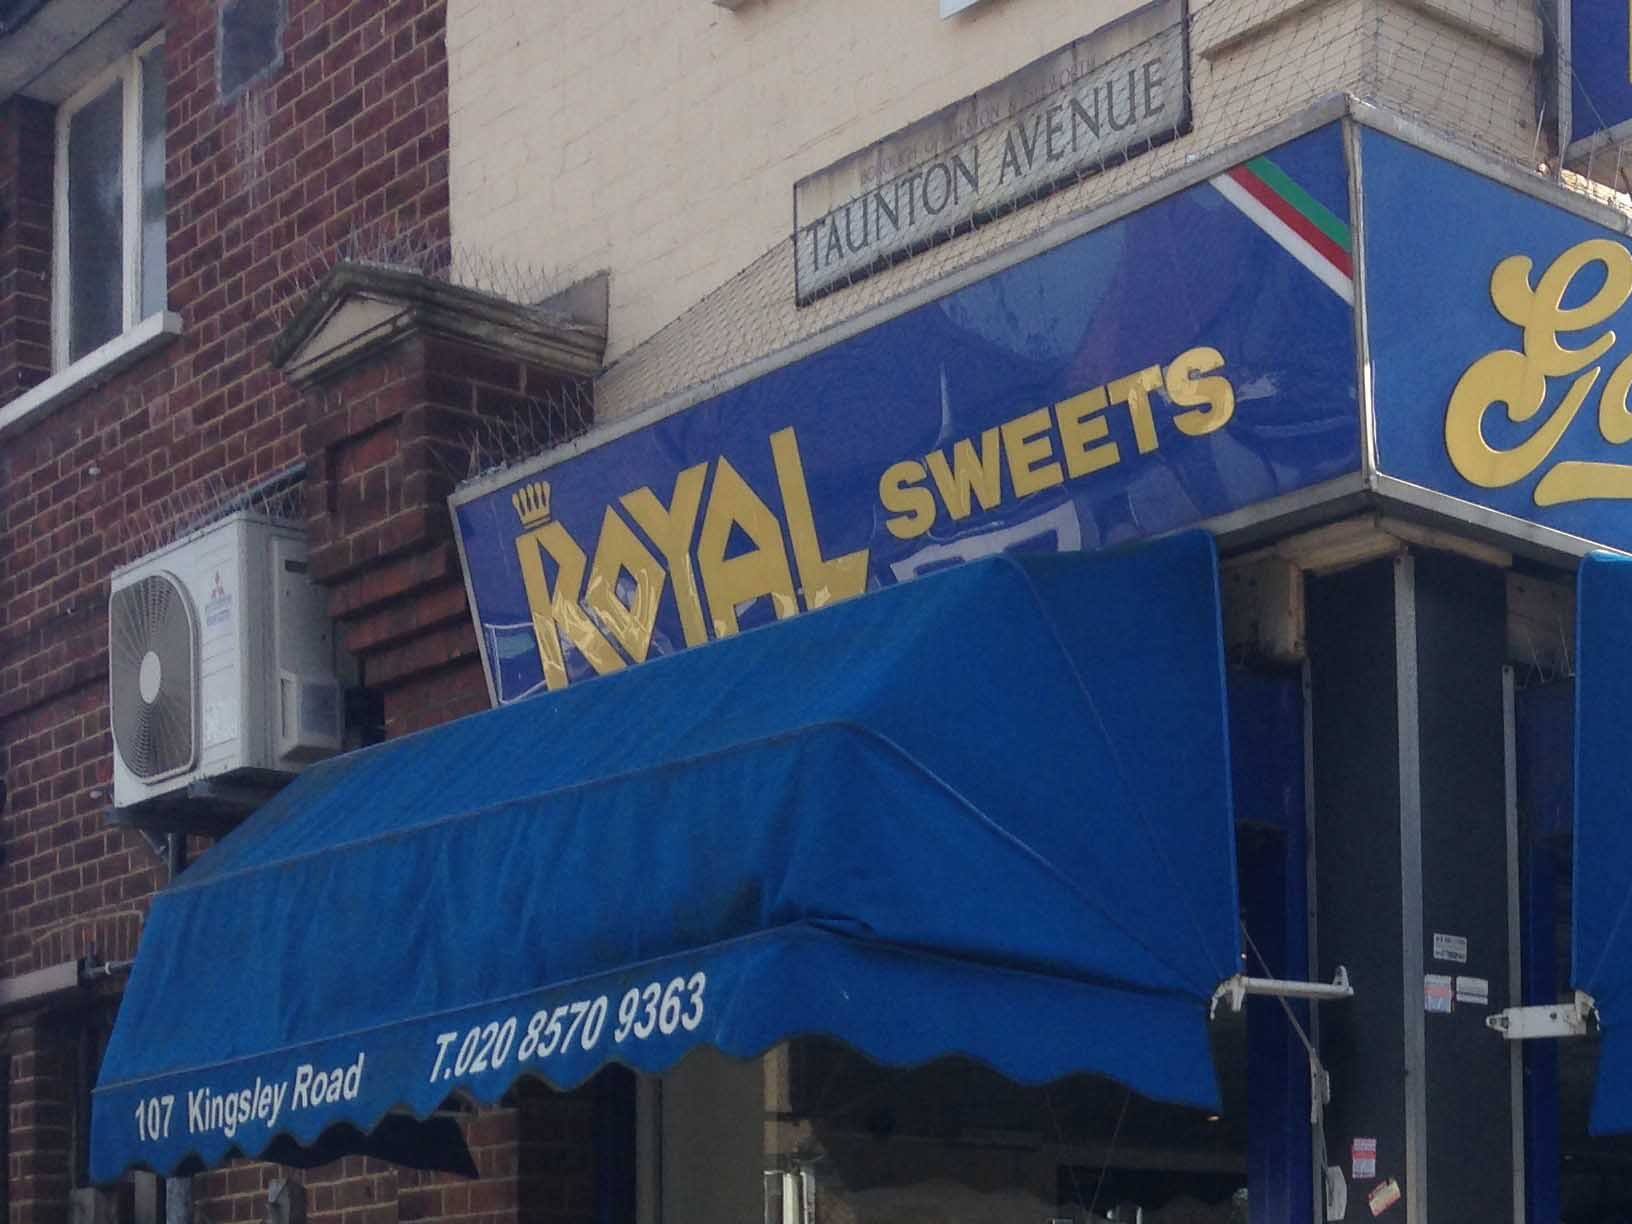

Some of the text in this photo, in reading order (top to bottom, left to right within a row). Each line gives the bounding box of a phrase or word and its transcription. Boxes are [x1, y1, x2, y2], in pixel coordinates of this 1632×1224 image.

[807, 57, 1167, 273] TAUNTON AVENUE
[515, 346, 1235, 690] ROYAL SWEETS
[135, 972, 707, 1141] 107 Kingsley Road T.020 8570 9363
